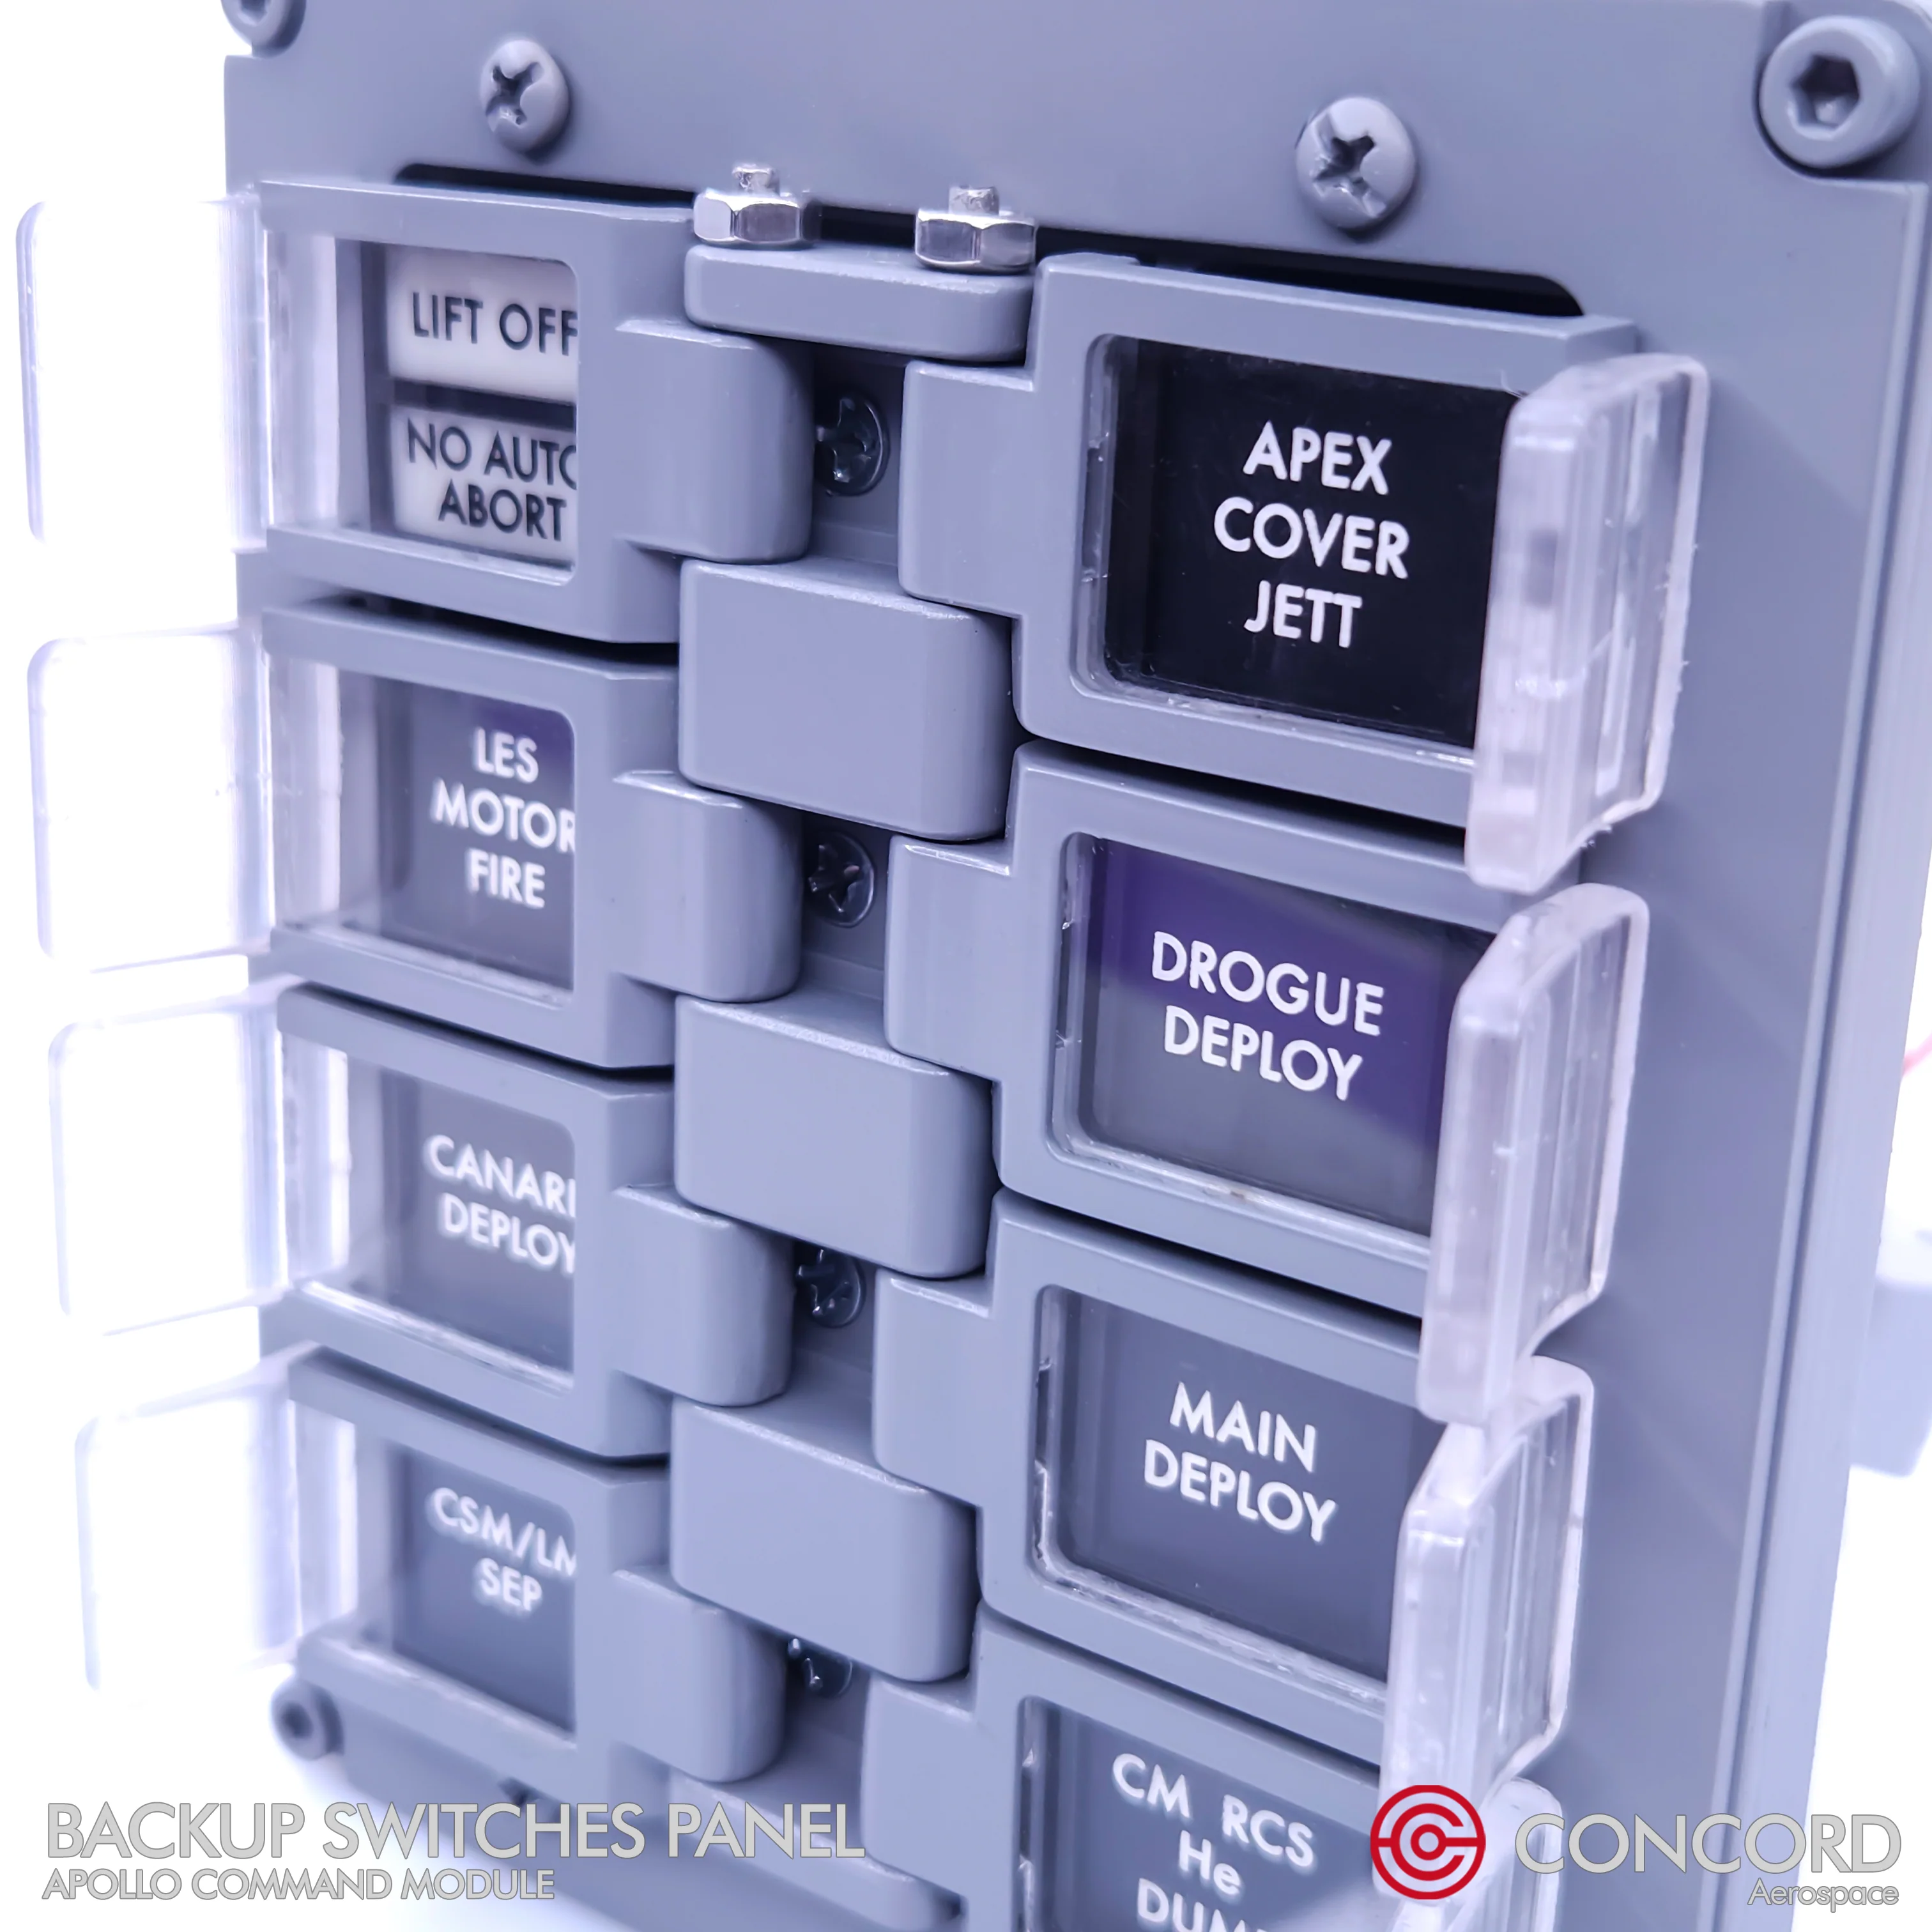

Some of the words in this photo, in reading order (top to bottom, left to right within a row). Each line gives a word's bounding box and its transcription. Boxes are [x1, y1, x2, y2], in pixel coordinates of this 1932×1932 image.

[412, 292, 484, 344] LIFT
[499, 303, 578, 356] OFF
[408, 418, 471, 471] NO
[1243, 420, 1392, 495] APEX
[438, 479, 567, 542] ABORT
[1214, 496, 1410, 579] COVER
[1243, 580, 1362, 648] JETT
[473, 726, 539, 783] LES
[431, 776, 576, 854] MOTOR
[465, 847, 546, 909] FIRE
[1152, 931, 1384, 1036] DROGUE
[1164, 1005, 1363, 1101] DEPLOY
[438, 1192, 576, 1274] DEPLOY
[1169, 1381, 1316, 1473] MAIN
[1144, 1439, 1337, 1542] DEPLOY
[476, 1557, 543, 1612] SEP
[1112, 1753, 1191, 1818] CM
[1222, 1793, 1314, 1867] RCS
[1179, 1830, 1241, 1895] He
